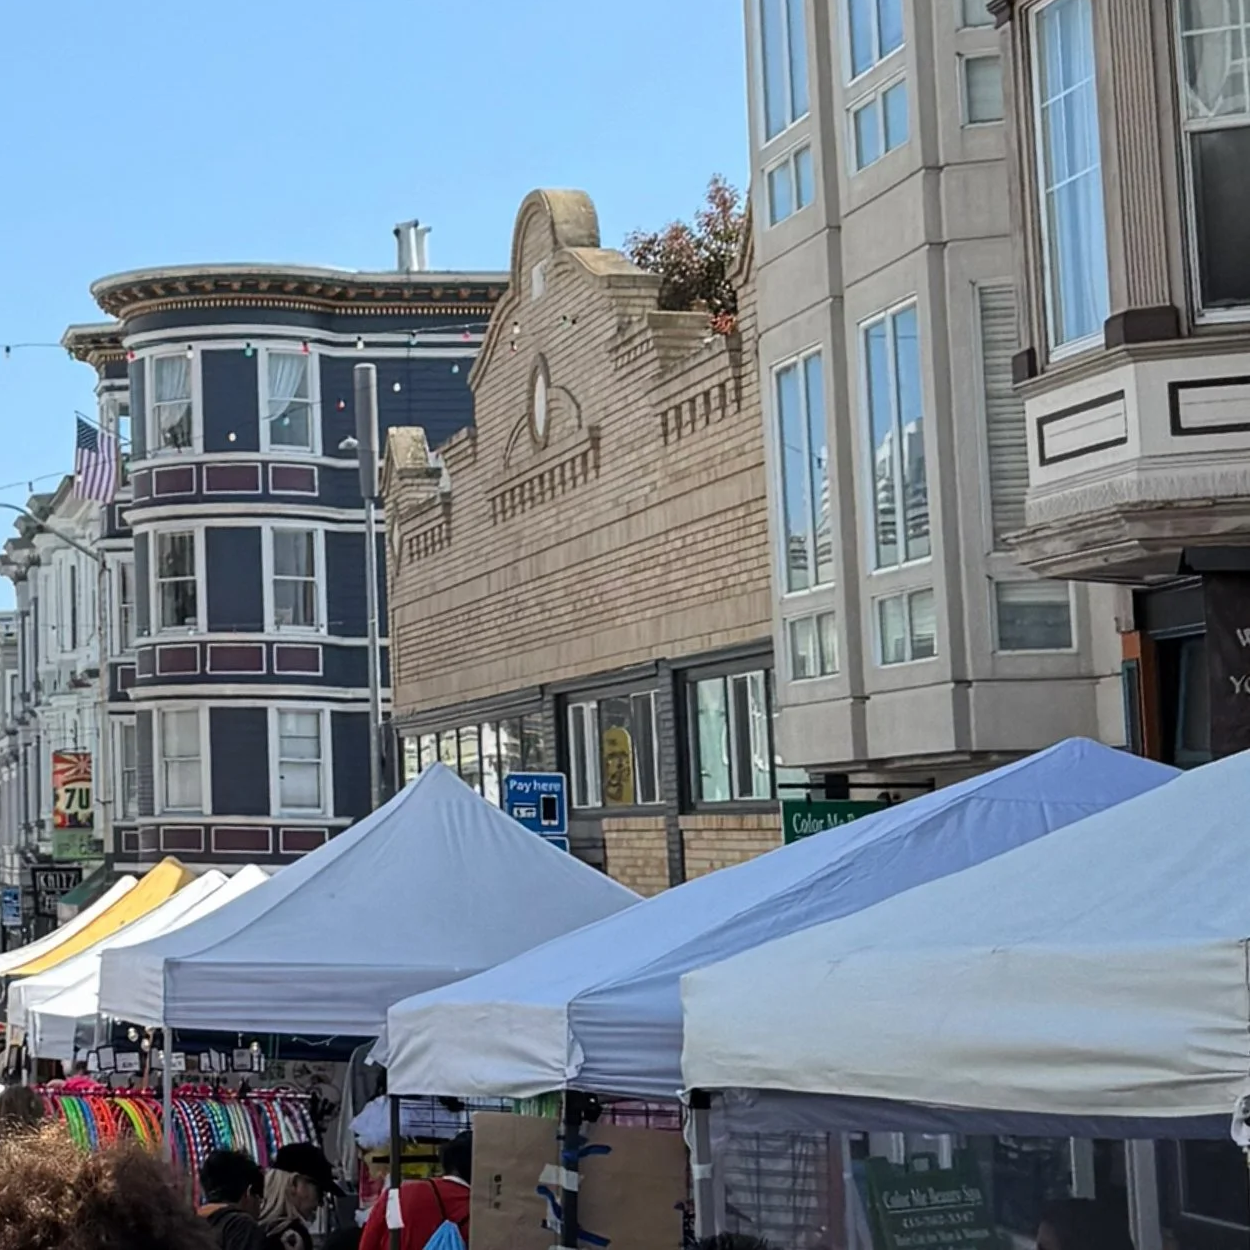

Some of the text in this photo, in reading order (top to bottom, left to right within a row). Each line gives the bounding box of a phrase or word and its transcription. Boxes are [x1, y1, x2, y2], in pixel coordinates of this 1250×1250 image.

[509, 779, 561, 793] Pay here
[792, 813, 824, 834] Color
